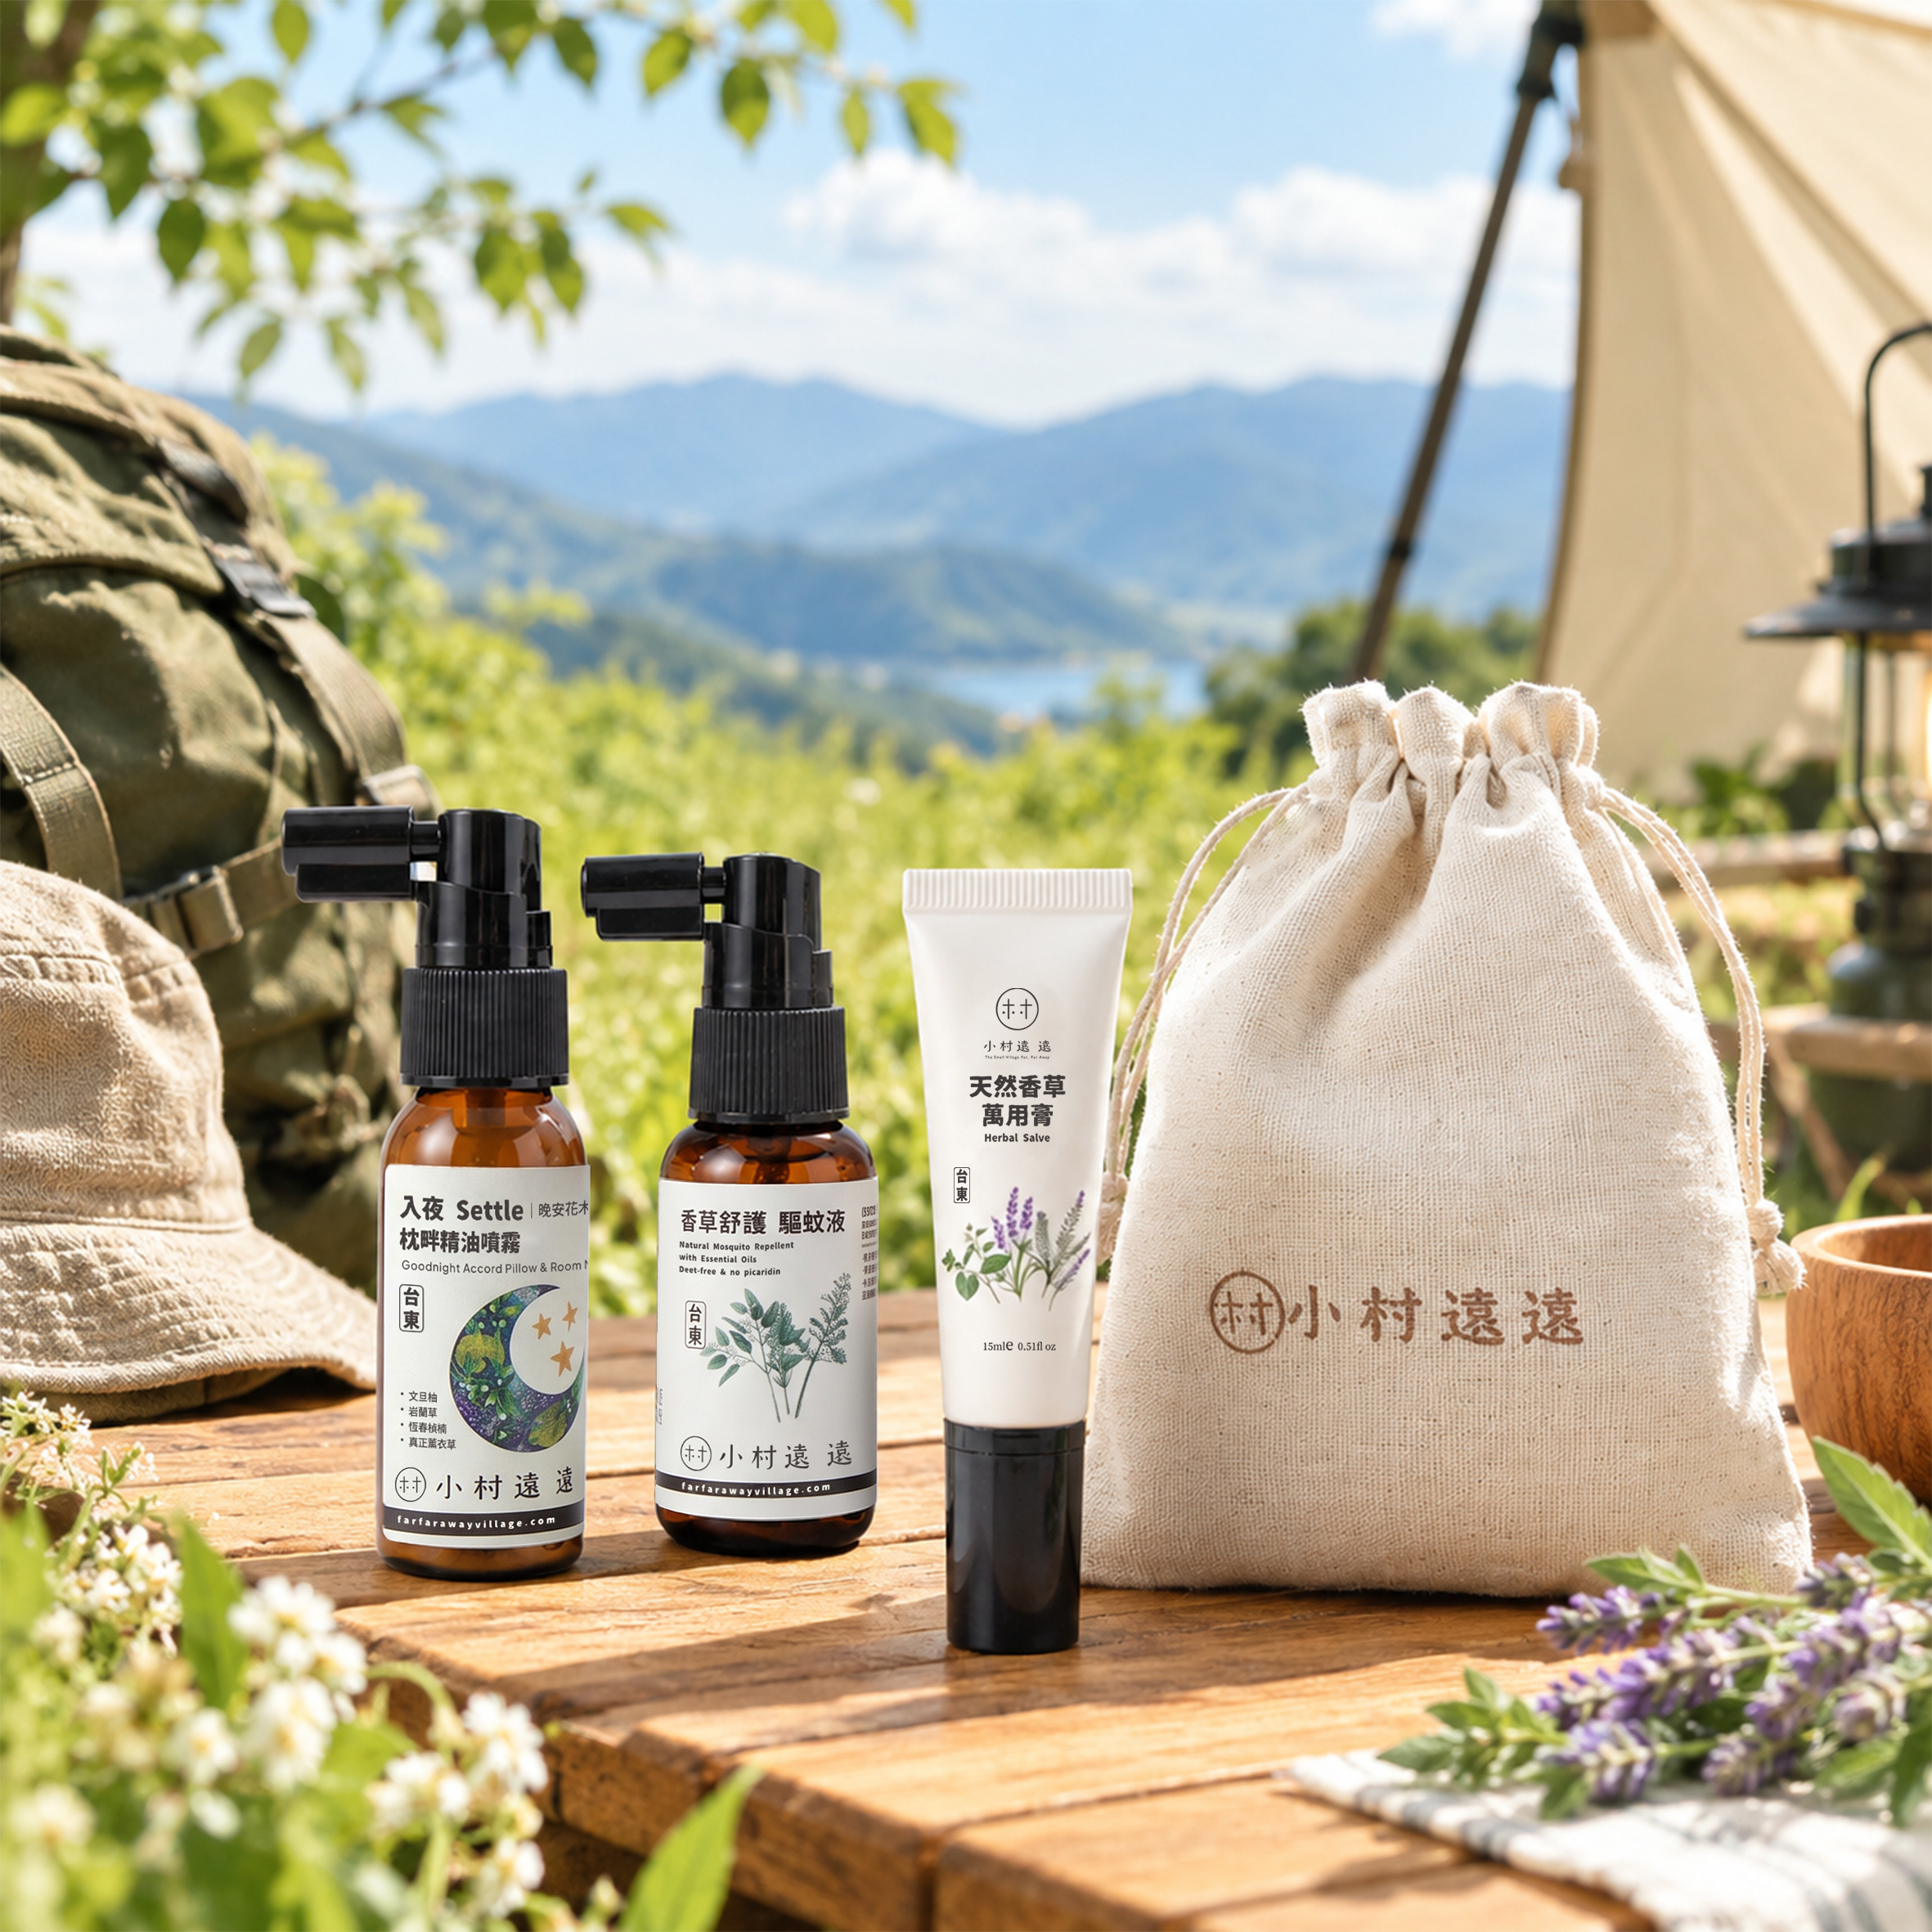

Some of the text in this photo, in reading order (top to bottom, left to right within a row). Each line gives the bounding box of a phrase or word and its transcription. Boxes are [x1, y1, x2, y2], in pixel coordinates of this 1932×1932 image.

[983, 1040, 1051, 1053] 小村遠遠
[969, 1074, 1066, 1099] 天然香草
[982, 1103, 1054, 1127] 萬用膏
[984, 1132, 1051, 1143] Herbal Salve
[956, 1169, 968, 1202] 台東
[399, 1195, 588, 1222] 入夜 Settle 晚安花木
[681, 1209, 767, 1235] 香草舒護
[778, 1209, 846, 1235] 驅蚊液
[399, 1227, 521, 1255] 枕畔精油噴霧
[679, 1241, 794, 1252] Natural Mosquito Repellent
[402, 1260, 461, 1275] Goodnight
[462, 1263, 503, 1274] Accord
[505, 1263, 537, 1274] Pillow
[539, 1262, 548, 1273] &
[550, 1261, 582, 1273] Room
[679, 1253, 757, 1264] with Essential Oils
[679, 1265, 717, 1275] Deet-free
[720, 1268, 726, 1276] &
[744, 1267, 781, 1278] picaridin
[403, 1287, 420, 1329] 台東
[1287, 1284, 1584, 1346] 小村遠遠
[688, 1304, 703, 1346] 台東
[1018, 1341, 1043, 1351] 0.51fl
[408, 1391, 438, 1404] 文旦柚
[408, 1406, 438, 1418] 岩蘭草
[719, 1440, 852, 1470] 小村遠遠
[436, 1466, 573, 1500] 小村遠遠
[681, 1482, 831, 1497] farfarawayvillage.com
[397, 1515, 555, 1530] farfarawayvillage.com
